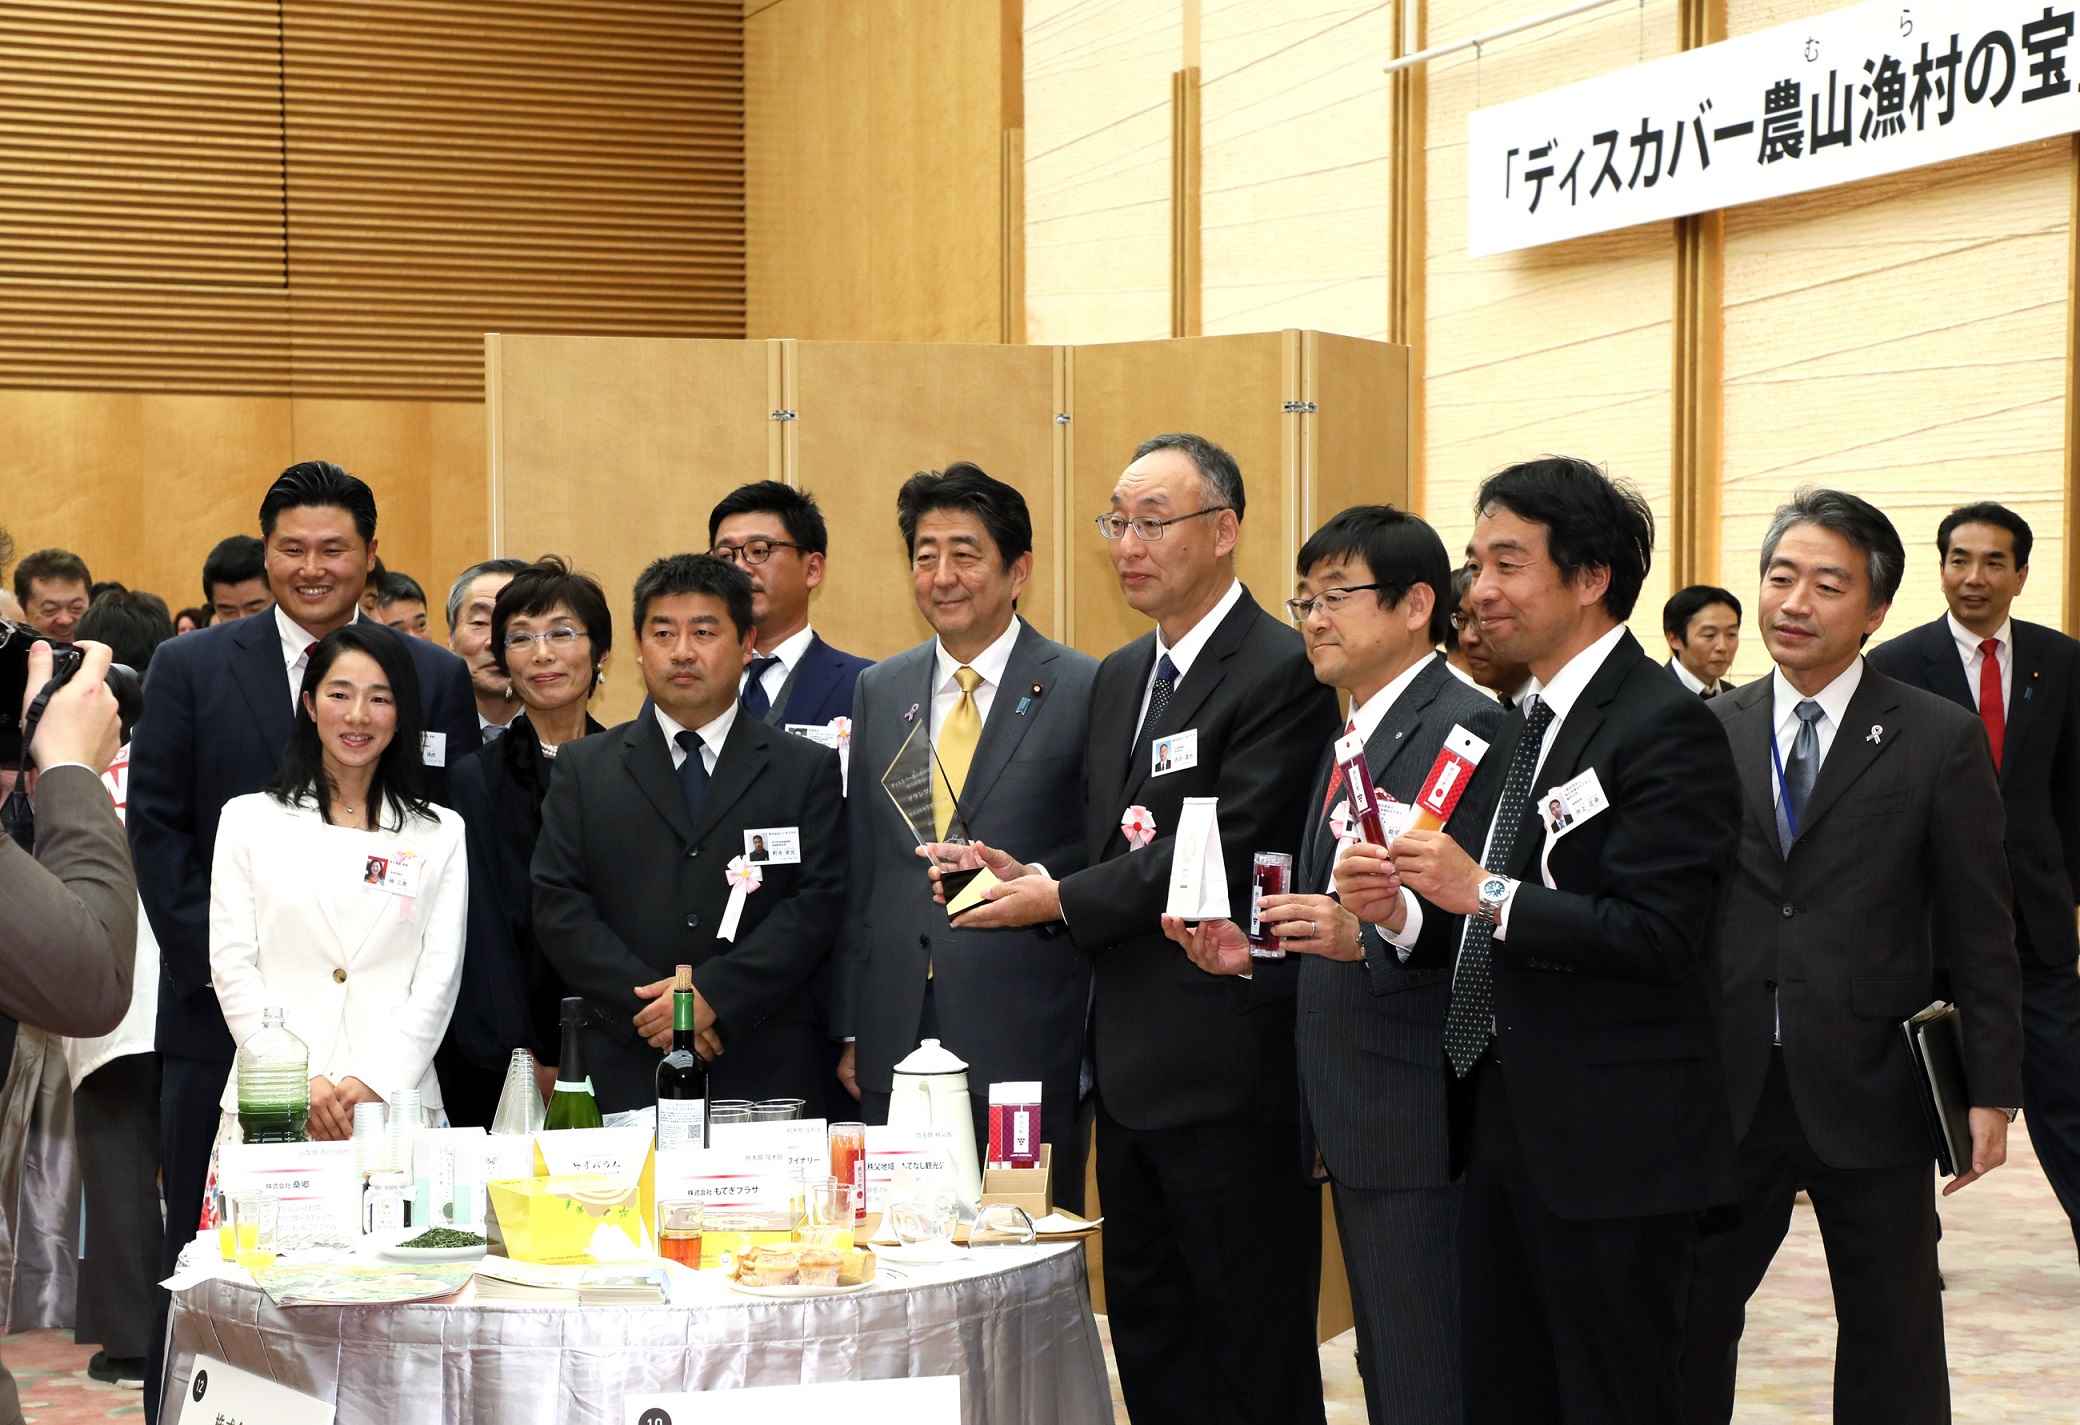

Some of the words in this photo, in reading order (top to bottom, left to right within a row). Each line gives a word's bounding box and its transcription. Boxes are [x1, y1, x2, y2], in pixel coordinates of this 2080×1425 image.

[1504, 6, 2080, 214] 「ディスカバー農山漁村の宝
[265, 1182, 291, 1190] 株式会社
[687, 1188, 713, 1196] 株式会社
[195, 1378, 206, 1394] 12
